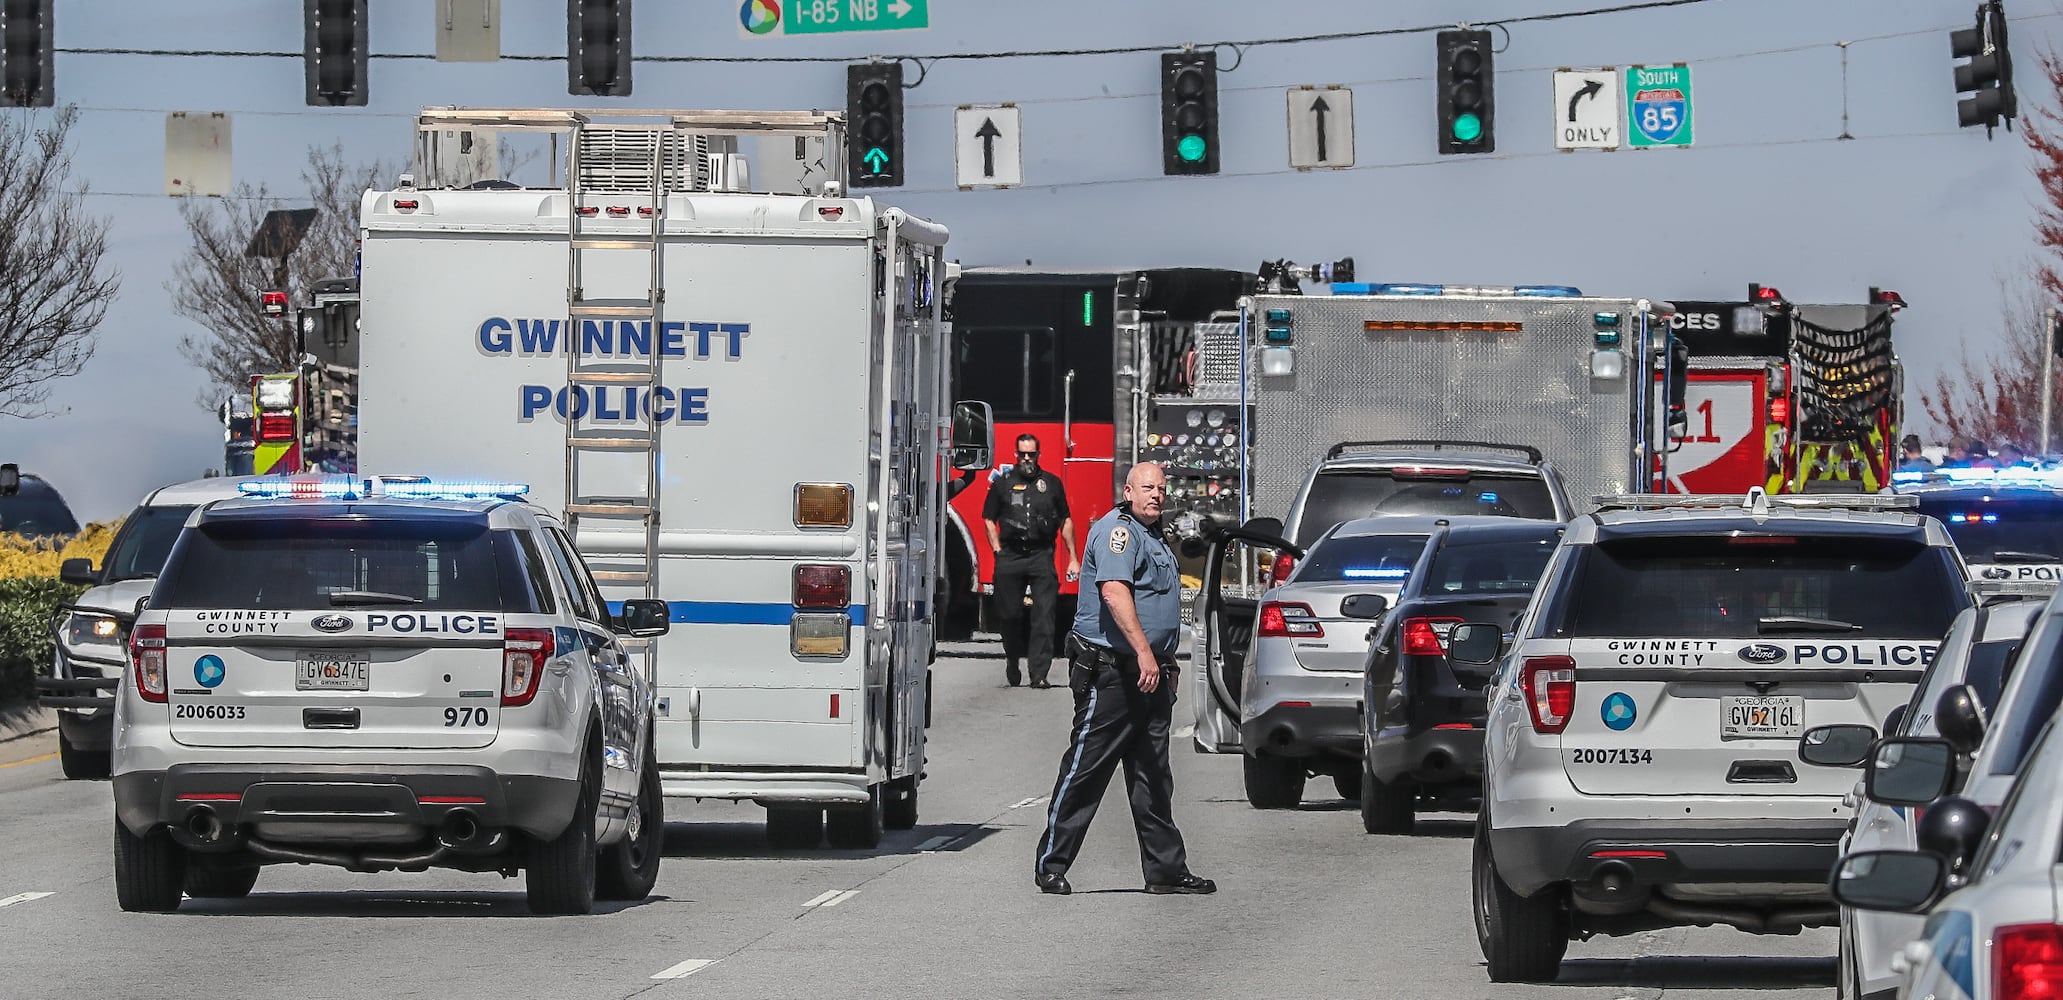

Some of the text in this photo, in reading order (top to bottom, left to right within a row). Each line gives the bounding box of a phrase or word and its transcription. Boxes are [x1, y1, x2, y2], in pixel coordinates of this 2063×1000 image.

[796, 0, 878, 24] I-85 NB
[1637, 69, 1679, 86] SOUTH
[1642, 106, 1678, 132] 85
[1565, 127, 1612, 142] ONLY
[476, 317, 751, 361] GWINNETT
[518, 384, 709, 425] POLICE
[196, 611, 292, 621] GWINNETT
[319, 616, 345, 627] Ford
[206, 623, 279, 633] COUNTY
[367, 614, 498, 634] POLICE
[1608, 641, 1718, 651] GWINNETT
[1748, 646, 1778, 661] Ford
[1618, 653, 1704, 666] COUNTY
[1739, 697, 1785, 706] GEORGIA
[176, 704, 246, 719] 2006033
[443, 707, 489, 727] 970
[1731, 706, 1799, 727] GV5216L
[1573, 749, 1652, 764] 2007134
